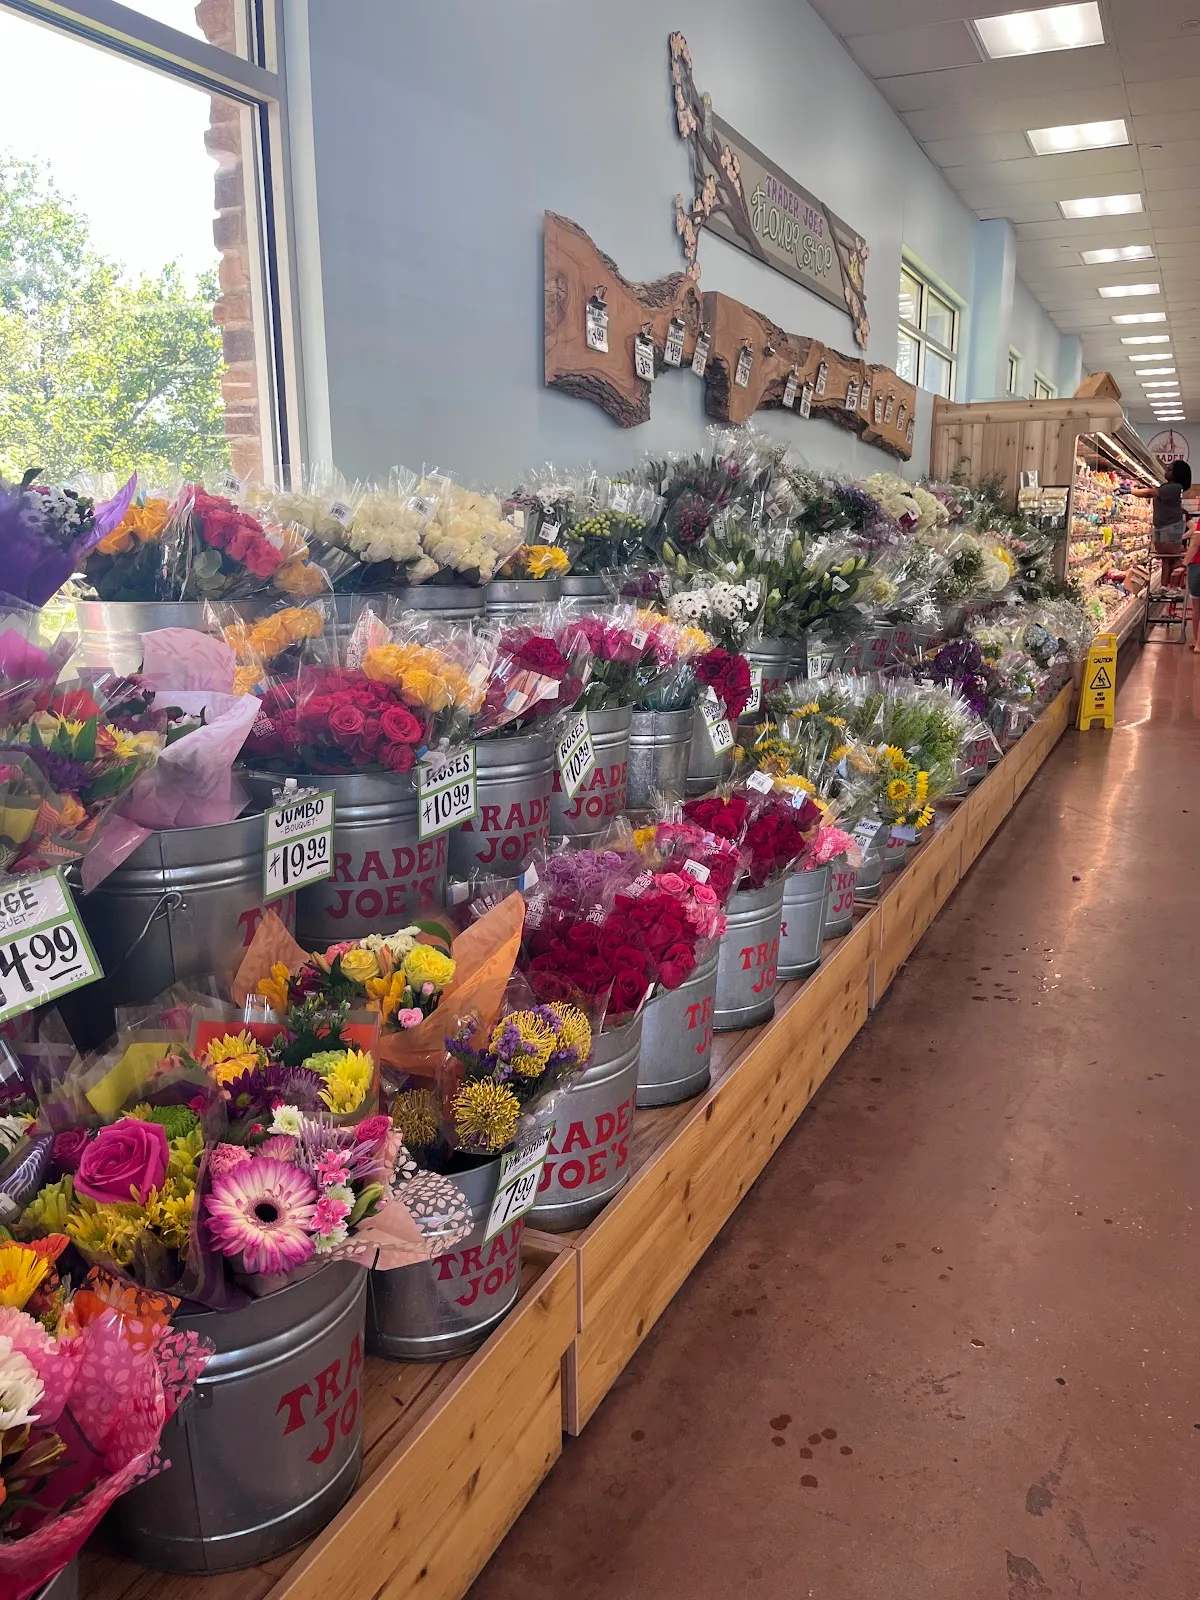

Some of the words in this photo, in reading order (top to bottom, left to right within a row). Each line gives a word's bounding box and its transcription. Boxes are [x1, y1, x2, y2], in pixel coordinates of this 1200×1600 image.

[765, 174, 800, 220] TRADER
[751, 183, 803, 270] FLOWER
[802, 234, 833, 277] SHOP
[561, 718, 585, 759] ROSES
[275, 799, 324, 828] JUMBO
[328, 836, 447, 883] RADER
[0, 886, 39, 918] GE
